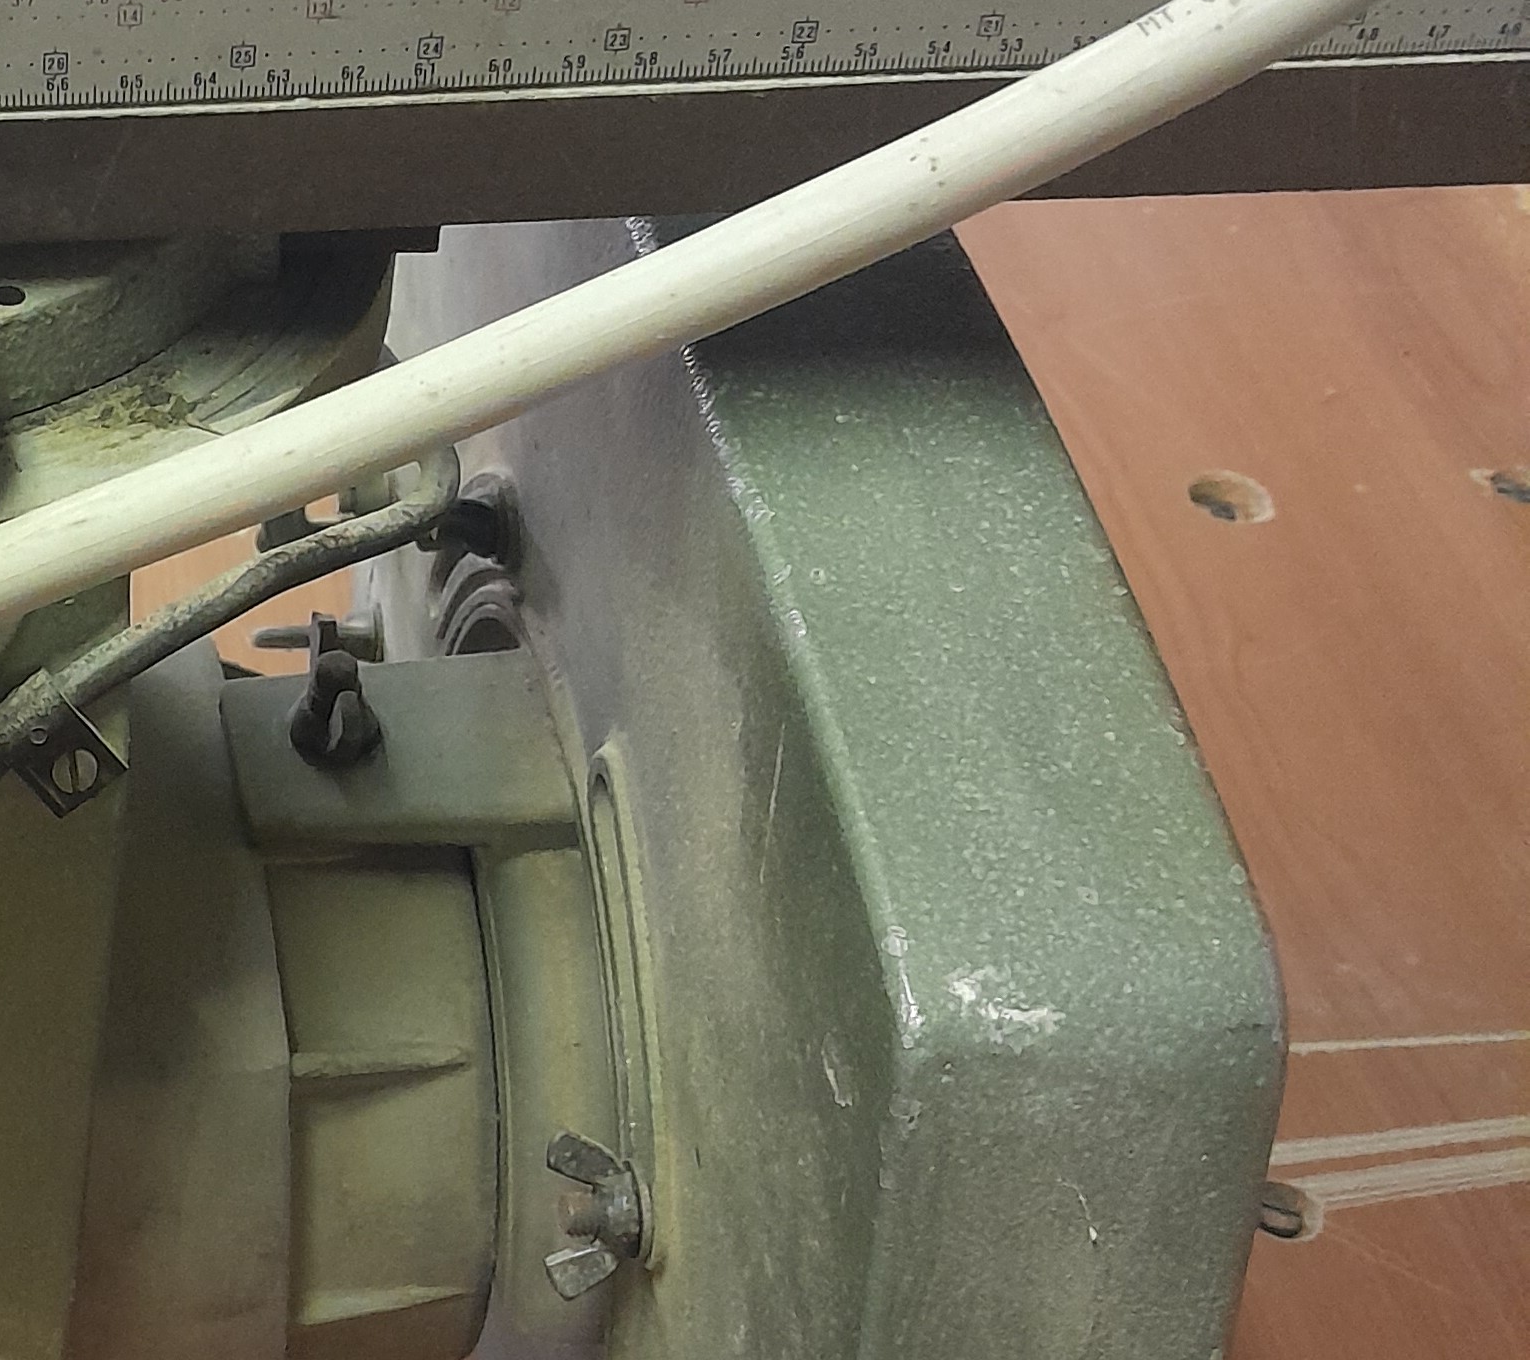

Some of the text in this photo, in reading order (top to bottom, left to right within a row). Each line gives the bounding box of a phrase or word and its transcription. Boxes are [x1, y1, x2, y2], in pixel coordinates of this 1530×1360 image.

[122, 10, 138, 22] 14
[234, 50, 252, 63] 25
[423, 42, 439, 55] 24
[609, 34, 627, 47] 23
[796, 26, 815, 39] 22
[46, 77, 69, 91] 66
[120, 75, 143, 89] 65
[194, 72, 217, 86] 64
[267, 69, 290, 84] 63
[341, 65, 365, 80] 62
[415, 62, 436, 76] 61
[488, 58, 512, 72] 60
[562, 55, 586, 70] 59
[635, 51, 658, 66] 58
[708, 48, 732, 63] 57
[781, 46, 804, 61] 56
[854, 43, 878, 57] 55
[927, 41, 951, 54] 54
[1000, 38, 1023, 52] 53
